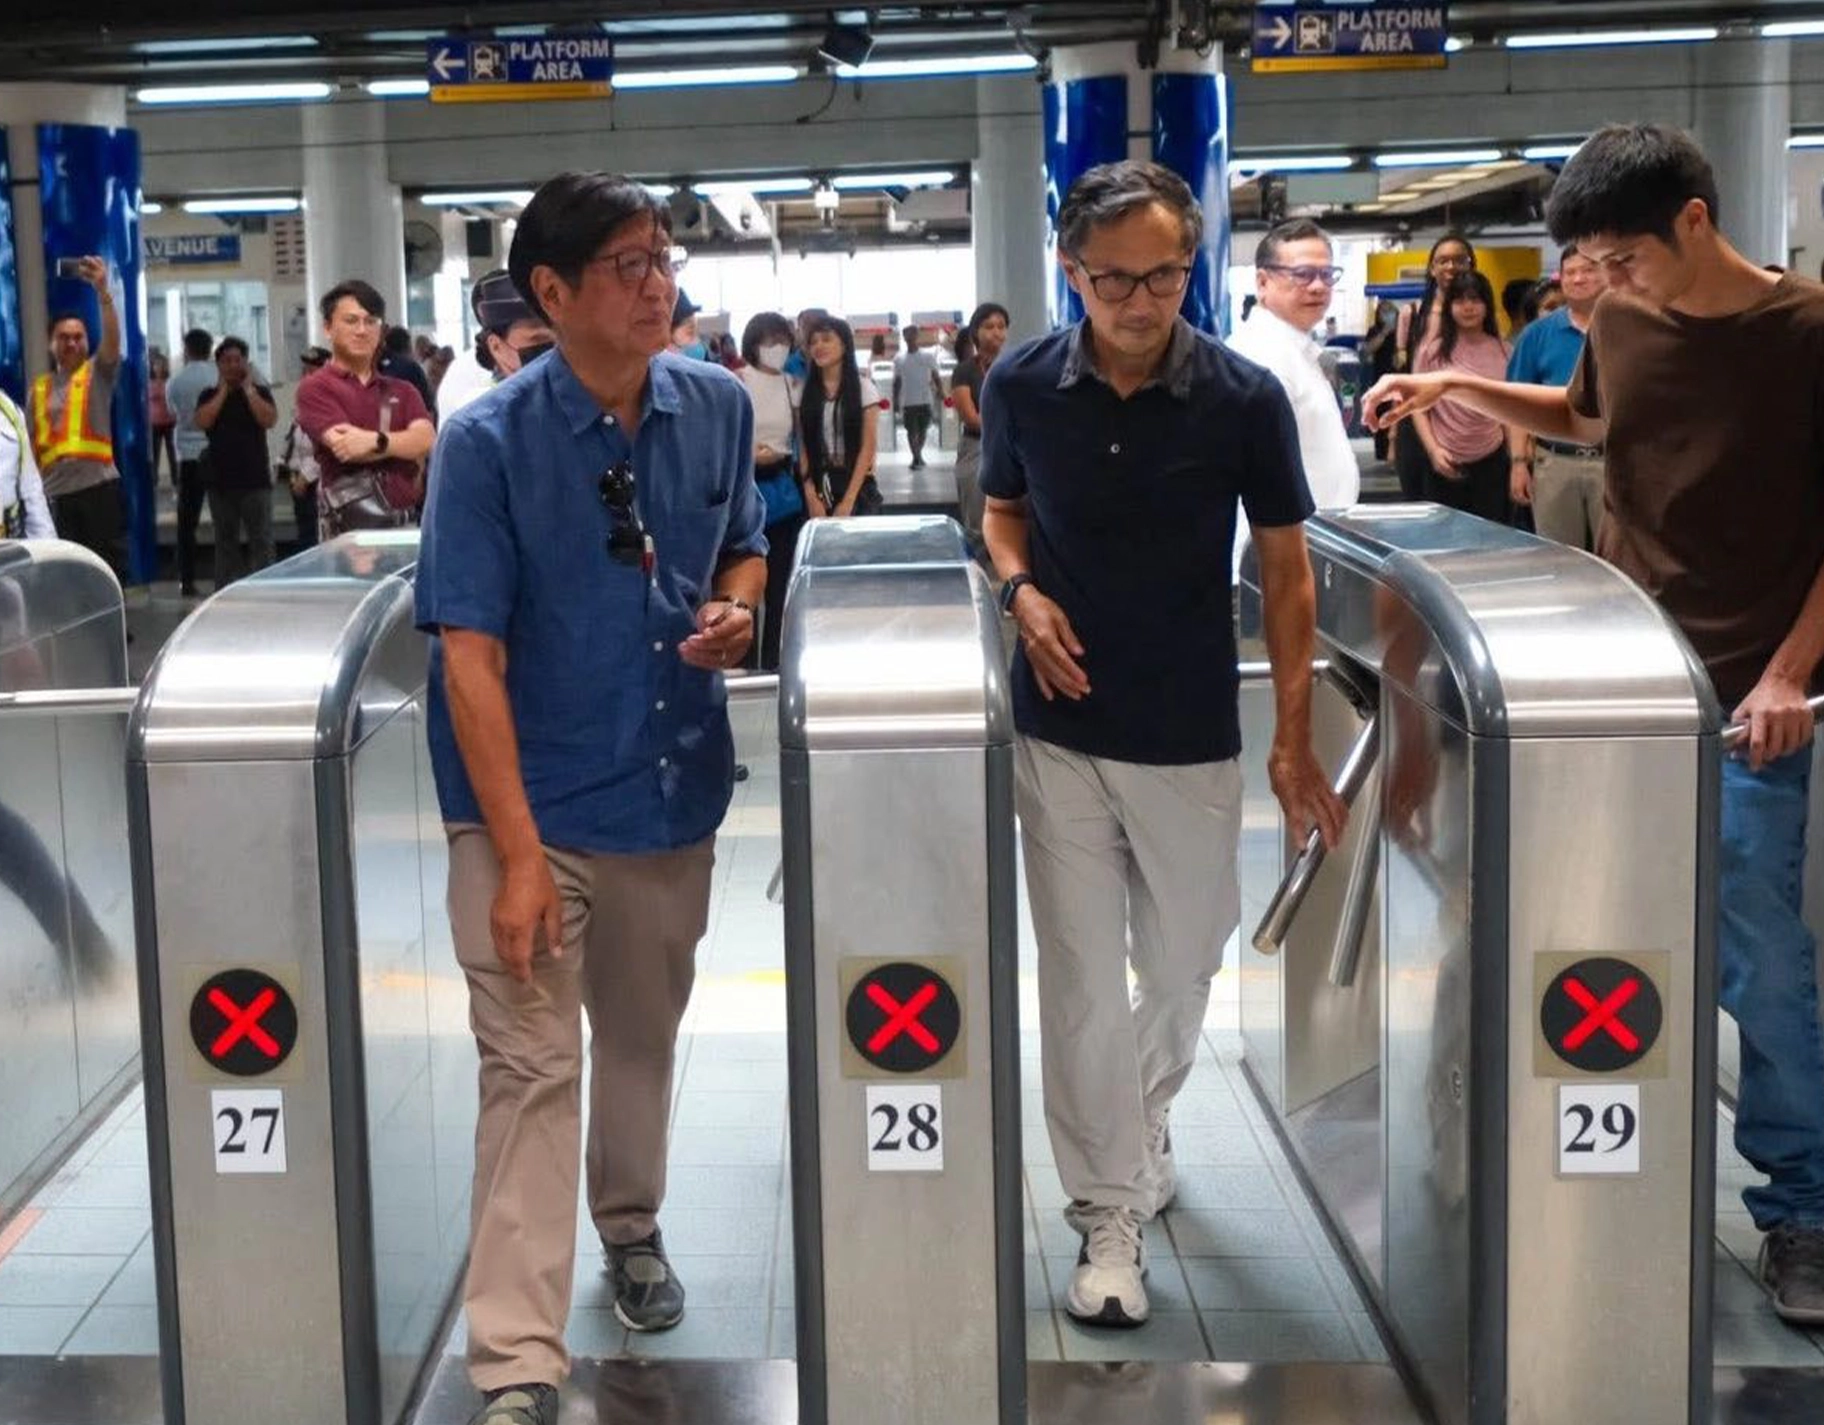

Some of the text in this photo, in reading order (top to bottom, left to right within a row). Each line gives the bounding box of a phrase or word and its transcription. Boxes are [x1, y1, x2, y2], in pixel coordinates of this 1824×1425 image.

[1338, 8, 1442, 30] PLATFORM
[510, 39, 609, 60] PLATFORM
[1360, 32, 1413, 51] AREA
[533, 61, 584, 80] AREA
[217, 1107, 280, 1154] 27
[871, 1103, 939, 1152] 28
[1564, 1103, 1636, 1153] 29
